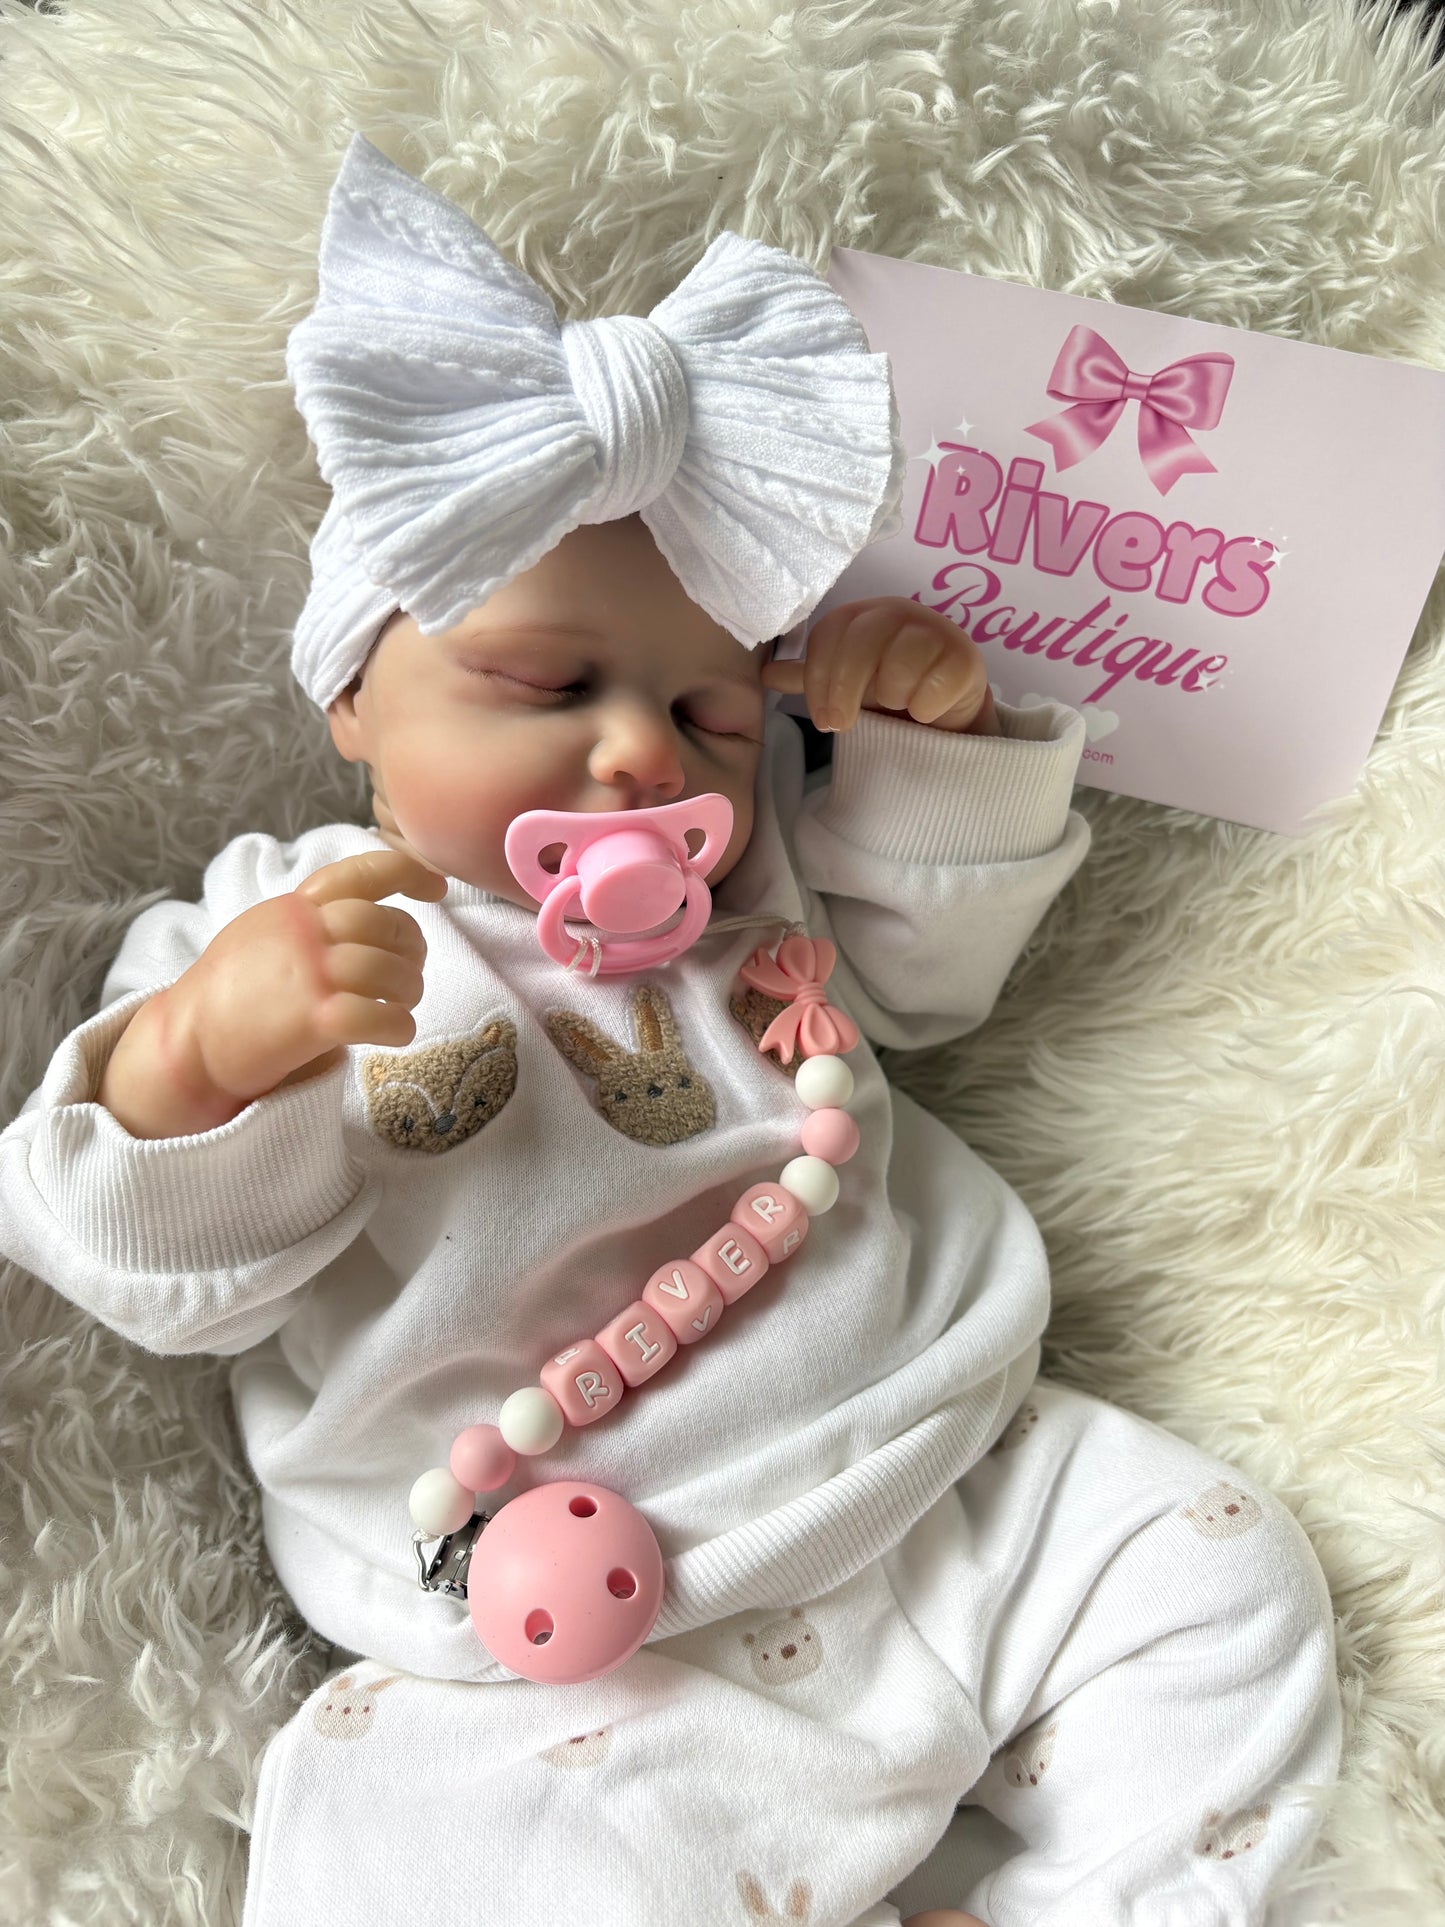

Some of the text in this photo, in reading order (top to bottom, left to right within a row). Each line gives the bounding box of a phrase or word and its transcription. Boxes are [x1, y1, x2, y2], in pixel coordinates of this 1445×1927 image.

[913, 441, 1280, 618] Rivers
[909, 562, 1228, 705] Boutique
[575, 1194, 785, 1408] RIVER
